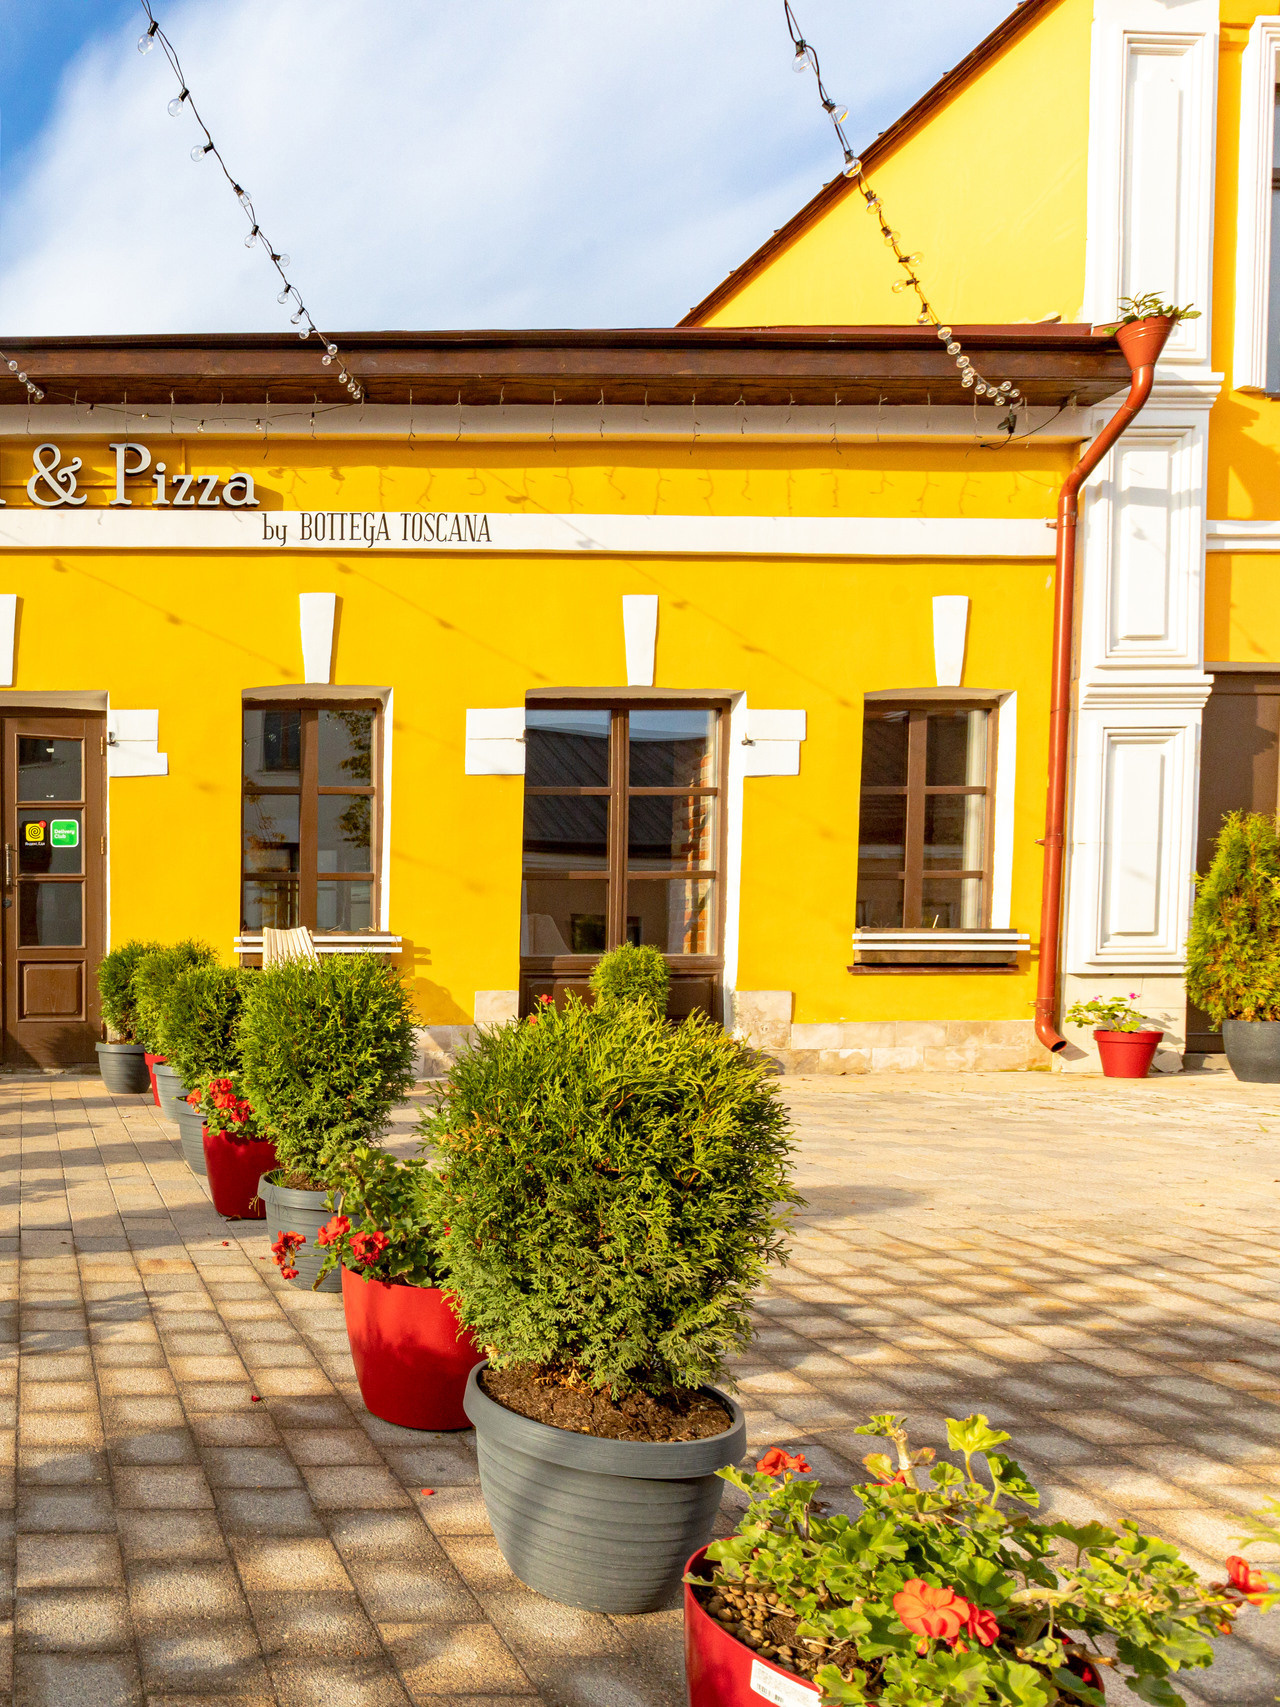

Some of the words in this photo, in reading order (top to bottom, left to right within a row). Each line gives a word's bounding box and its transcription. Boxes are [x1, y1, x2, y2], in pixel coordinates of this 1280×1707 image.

[27, 443, 87, 507] &
[109, 443, 260, 507] Pizza
[262, 513, 288, 547] by
[300, 512, 392, 548] BOTTEGA
[400, 513, 493, 542] TOSCANA
